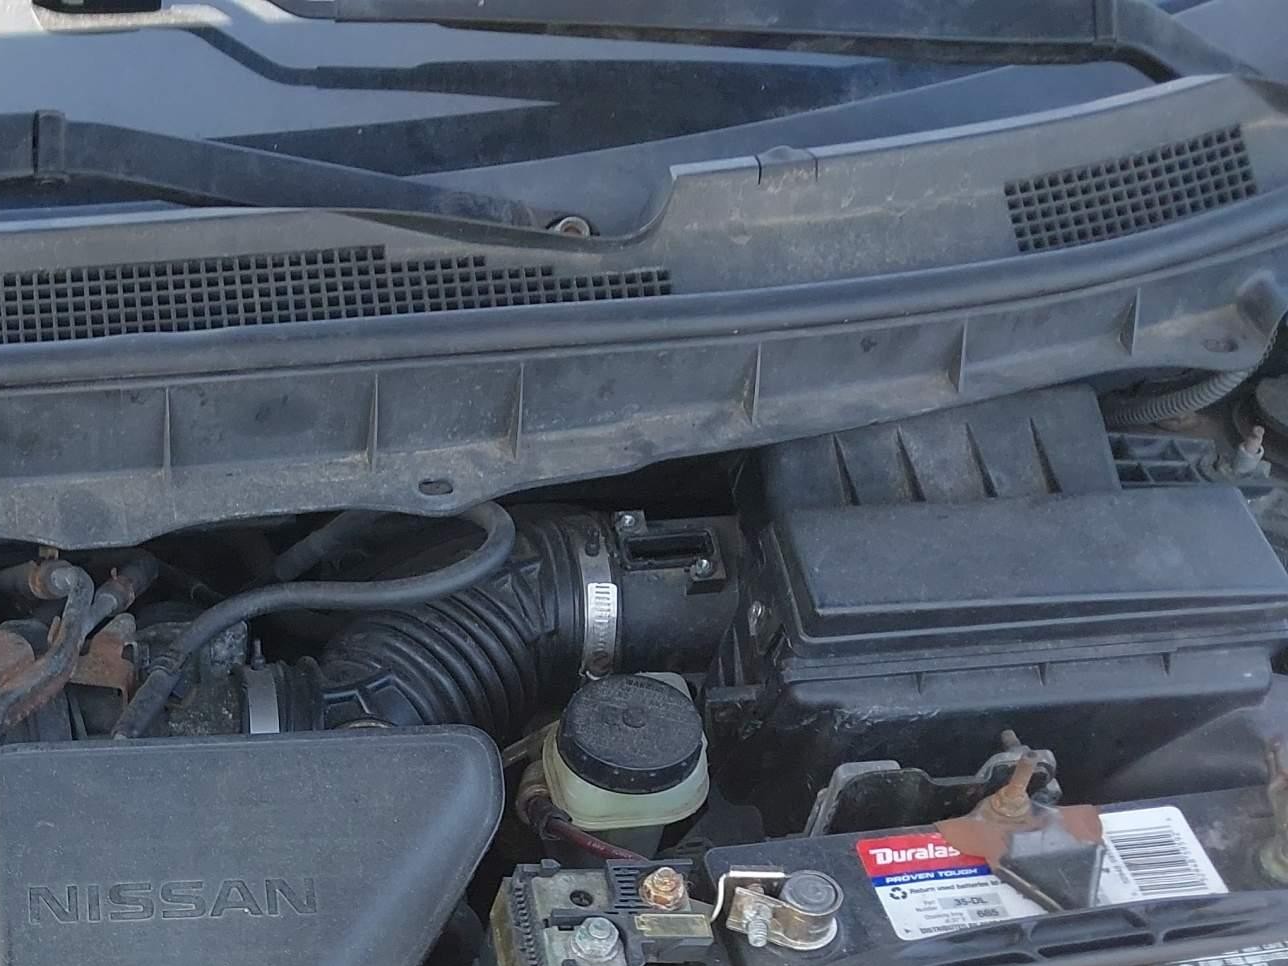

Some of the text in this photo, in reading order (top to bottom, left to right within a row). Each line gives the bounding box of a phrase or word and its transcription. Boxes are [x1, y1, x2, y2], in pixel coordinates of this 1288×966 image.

[869, 843, 961, 865] Duralas
[885, 867, 978, 884] PROVEN TOUGH
[28, 878, 318, 924] NISSAN
